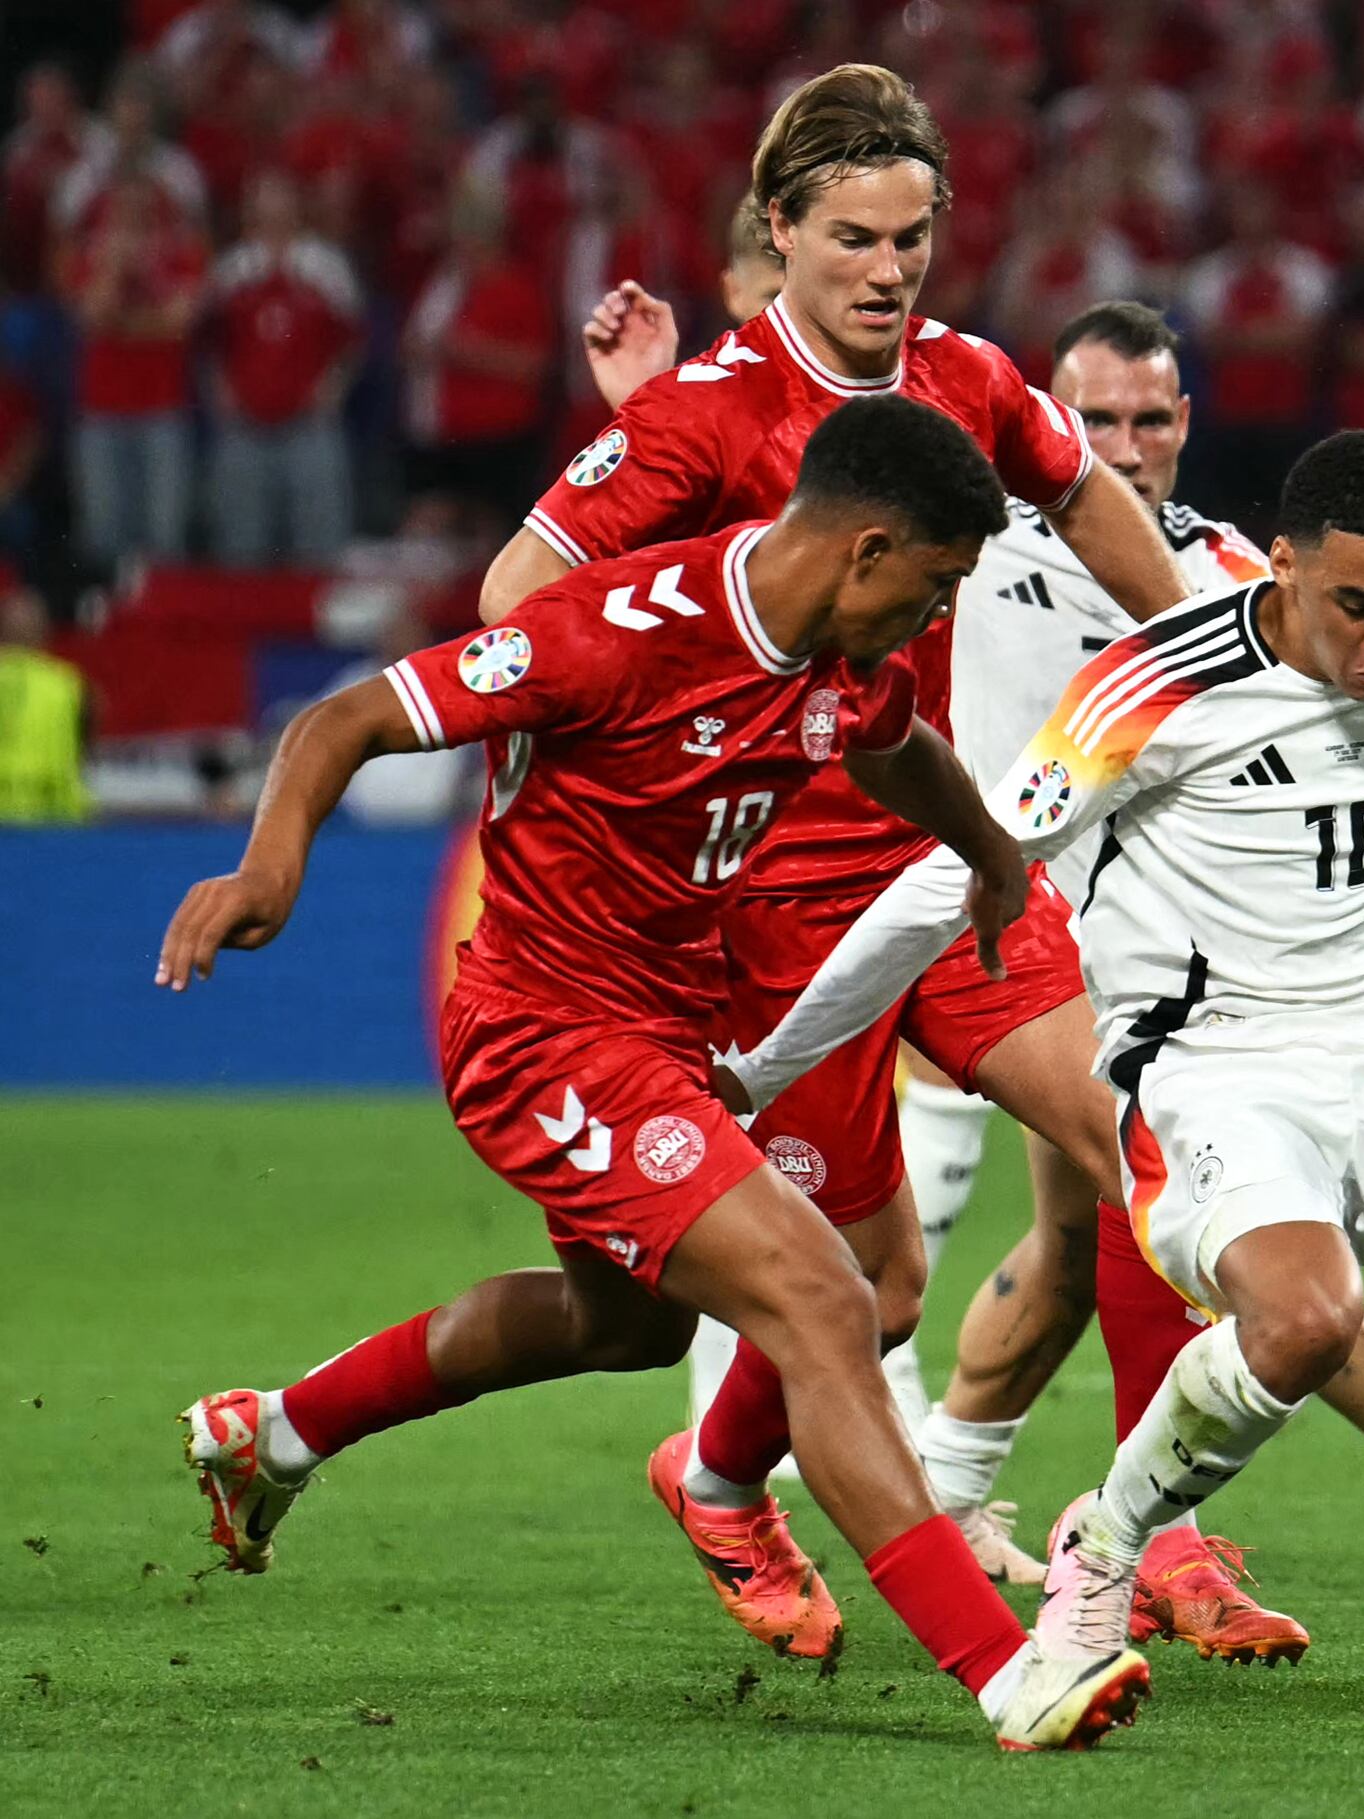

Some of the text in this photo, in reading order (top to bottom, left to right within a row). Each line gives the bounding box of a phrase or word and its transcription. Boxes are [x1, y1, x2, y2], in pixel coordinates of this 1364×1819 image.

[691, 790, 774, 884] 18
[646, 1127, 690, 1169] DBU
[776, 1155, 814, 1174] DBU
